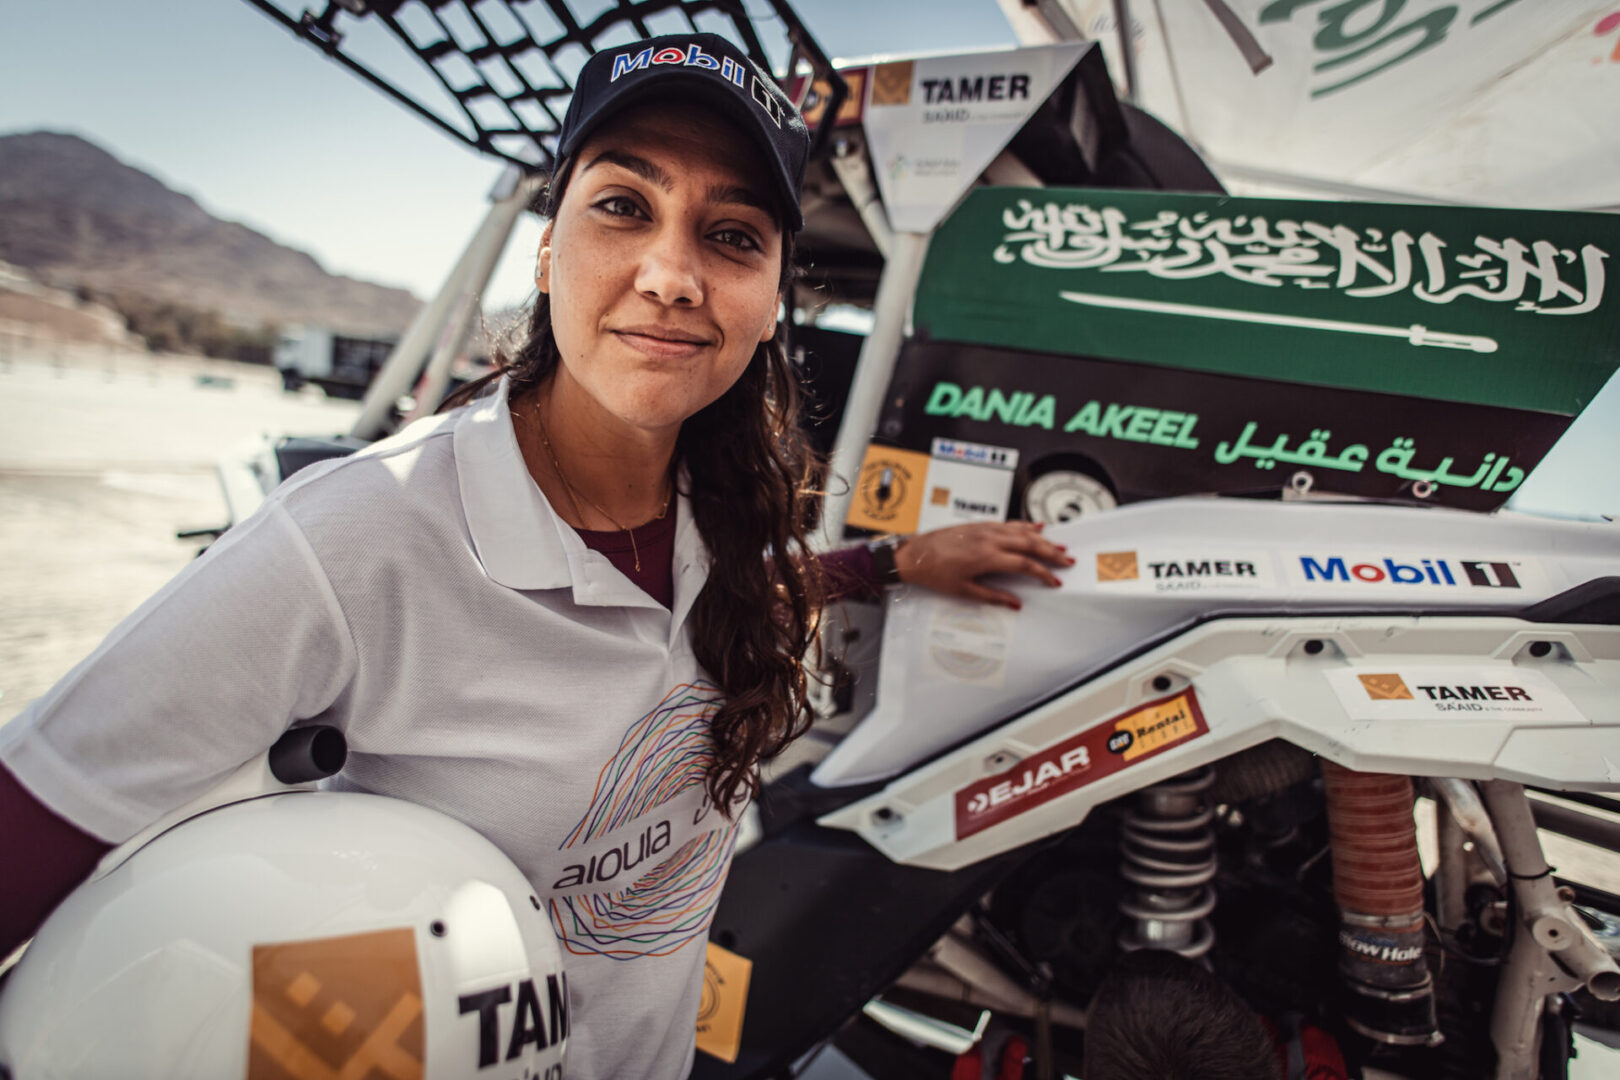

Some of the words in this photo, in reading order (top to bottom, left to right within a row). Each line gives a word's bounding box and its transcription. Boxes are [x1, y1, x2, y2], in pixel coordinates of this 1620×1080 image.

[610, 43, 746, 89] Mobil
[921, 74, 1030, 104] TAMER
[925, 381, 1056, 430] DANIA
[1063, 400, 1200, 450] AKEEL
[1213, 421, 1370, 473] عقيل
[1375, 436, 1525, 492] دانية
[1147, 560, 1257, 579] TAMER
[1298, 556, 1457, 587] Mobil
[1416, 685, 1534, 701] TAMER
[1136, 708, 1187, 739] Rental
[988, 745, 1091, 806] EJAR
